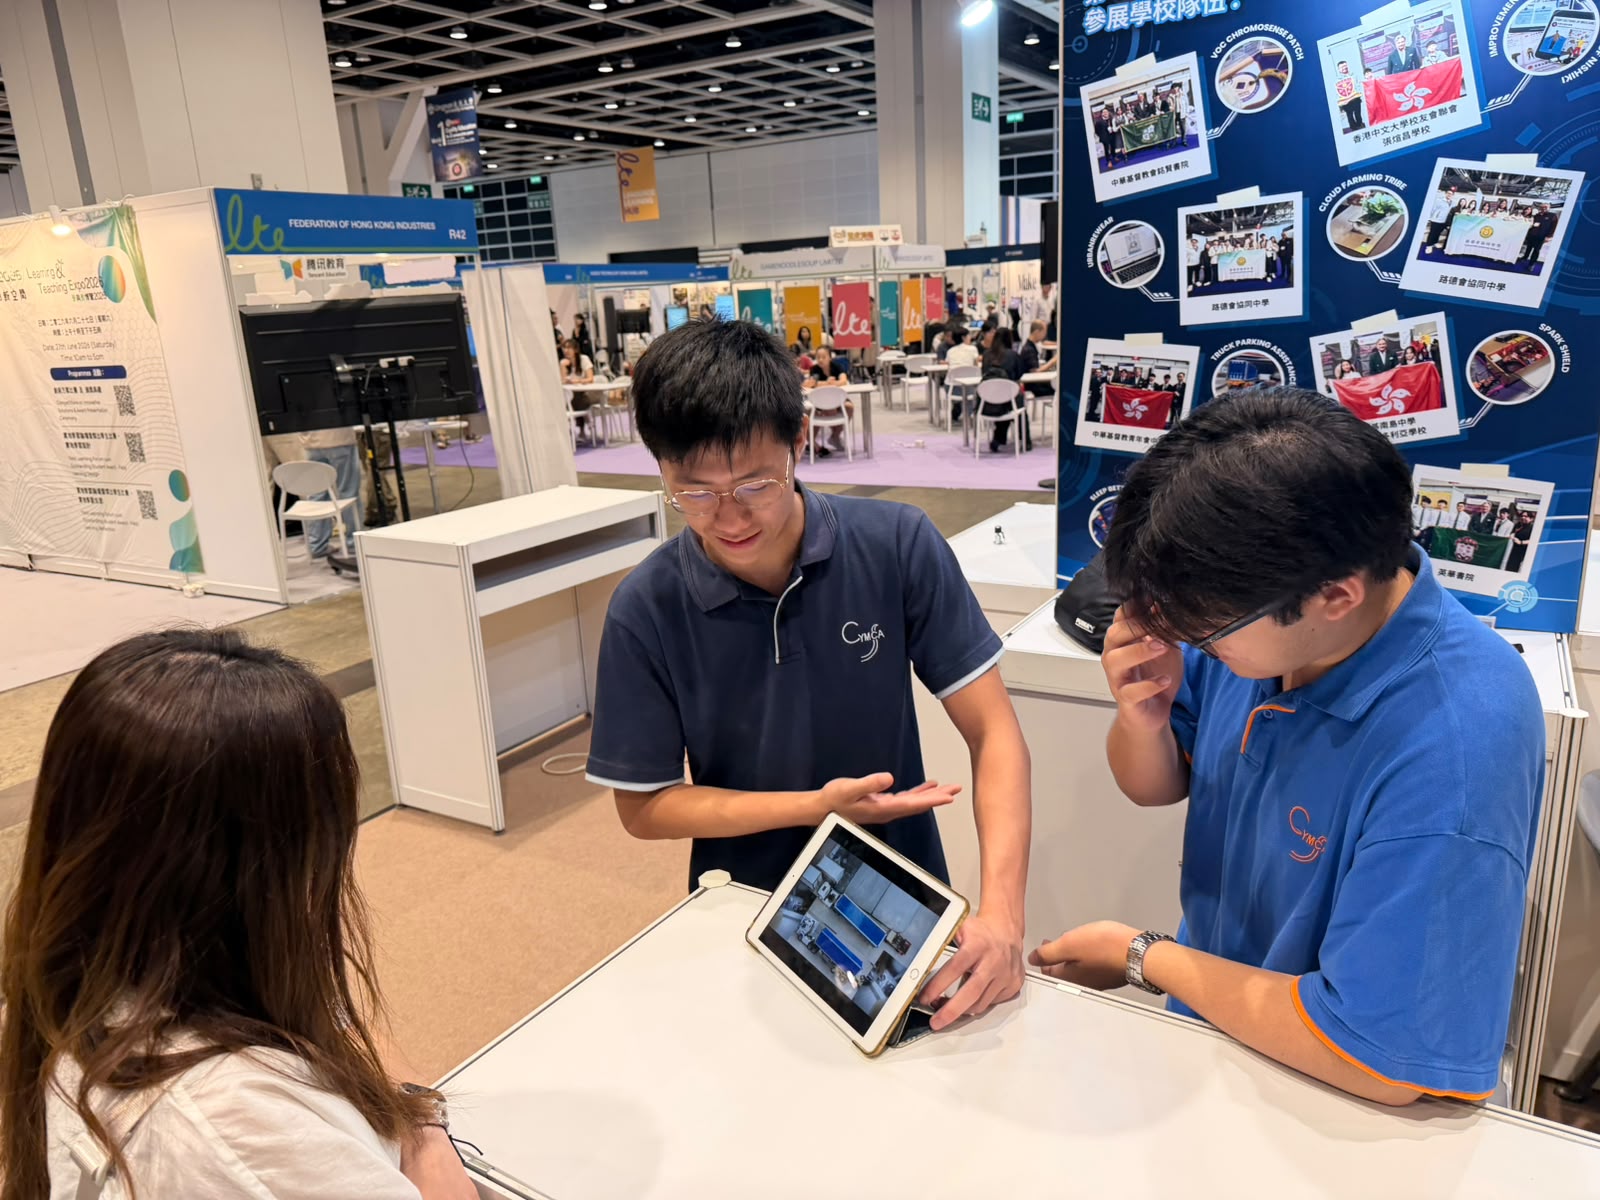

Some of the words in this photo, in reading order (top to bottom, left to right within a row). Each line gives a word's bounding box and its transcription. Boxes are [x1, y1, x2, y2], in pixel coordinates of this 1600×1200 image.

[1084, 0, 1240, 34] 參展學校隊伍
[1210, 41, 1227, 59] VOC
[1226, 23, 1289, 43] CHROMOSENSE
[1285, 34, 1305, 60] PATCH
[1353, 104, 1457, 144] 香港中文大學校友會聯會
[1111, 160, 1189, 187] 中華基督教會銘賢書院
[1319, 186, 1342, 212] CLOUD
[1341, 173, 1384, 189] FARMING
[1384, 175, 1407, 191] TRIBE
[288, 218, 338, 229] FEDERATION
[339, 219, 351, 229] OF
[351, 220, 373, 230] HONG
[374, 220, 395, 230] KONG
[396, 221, 436, 231] INDUSTRIES
[449, 229, 467, 240] R42
[37, 281, 69, 294] Teaching
[1438, 275, 1506, 291] 路德會協同中學
[1211, 298, 1269, 311] 路德會協同中學
[833, 301, 872, 336] lte
[1210, 342, 1236, 361] TRUCK
[1235, 338, 1272, 349] PARKING
[1538, 323, 1565, 345] SPARK
[1560, 344, 1571, 373] SHIELD
[1438, 568, 1475, 581] 英華書院
